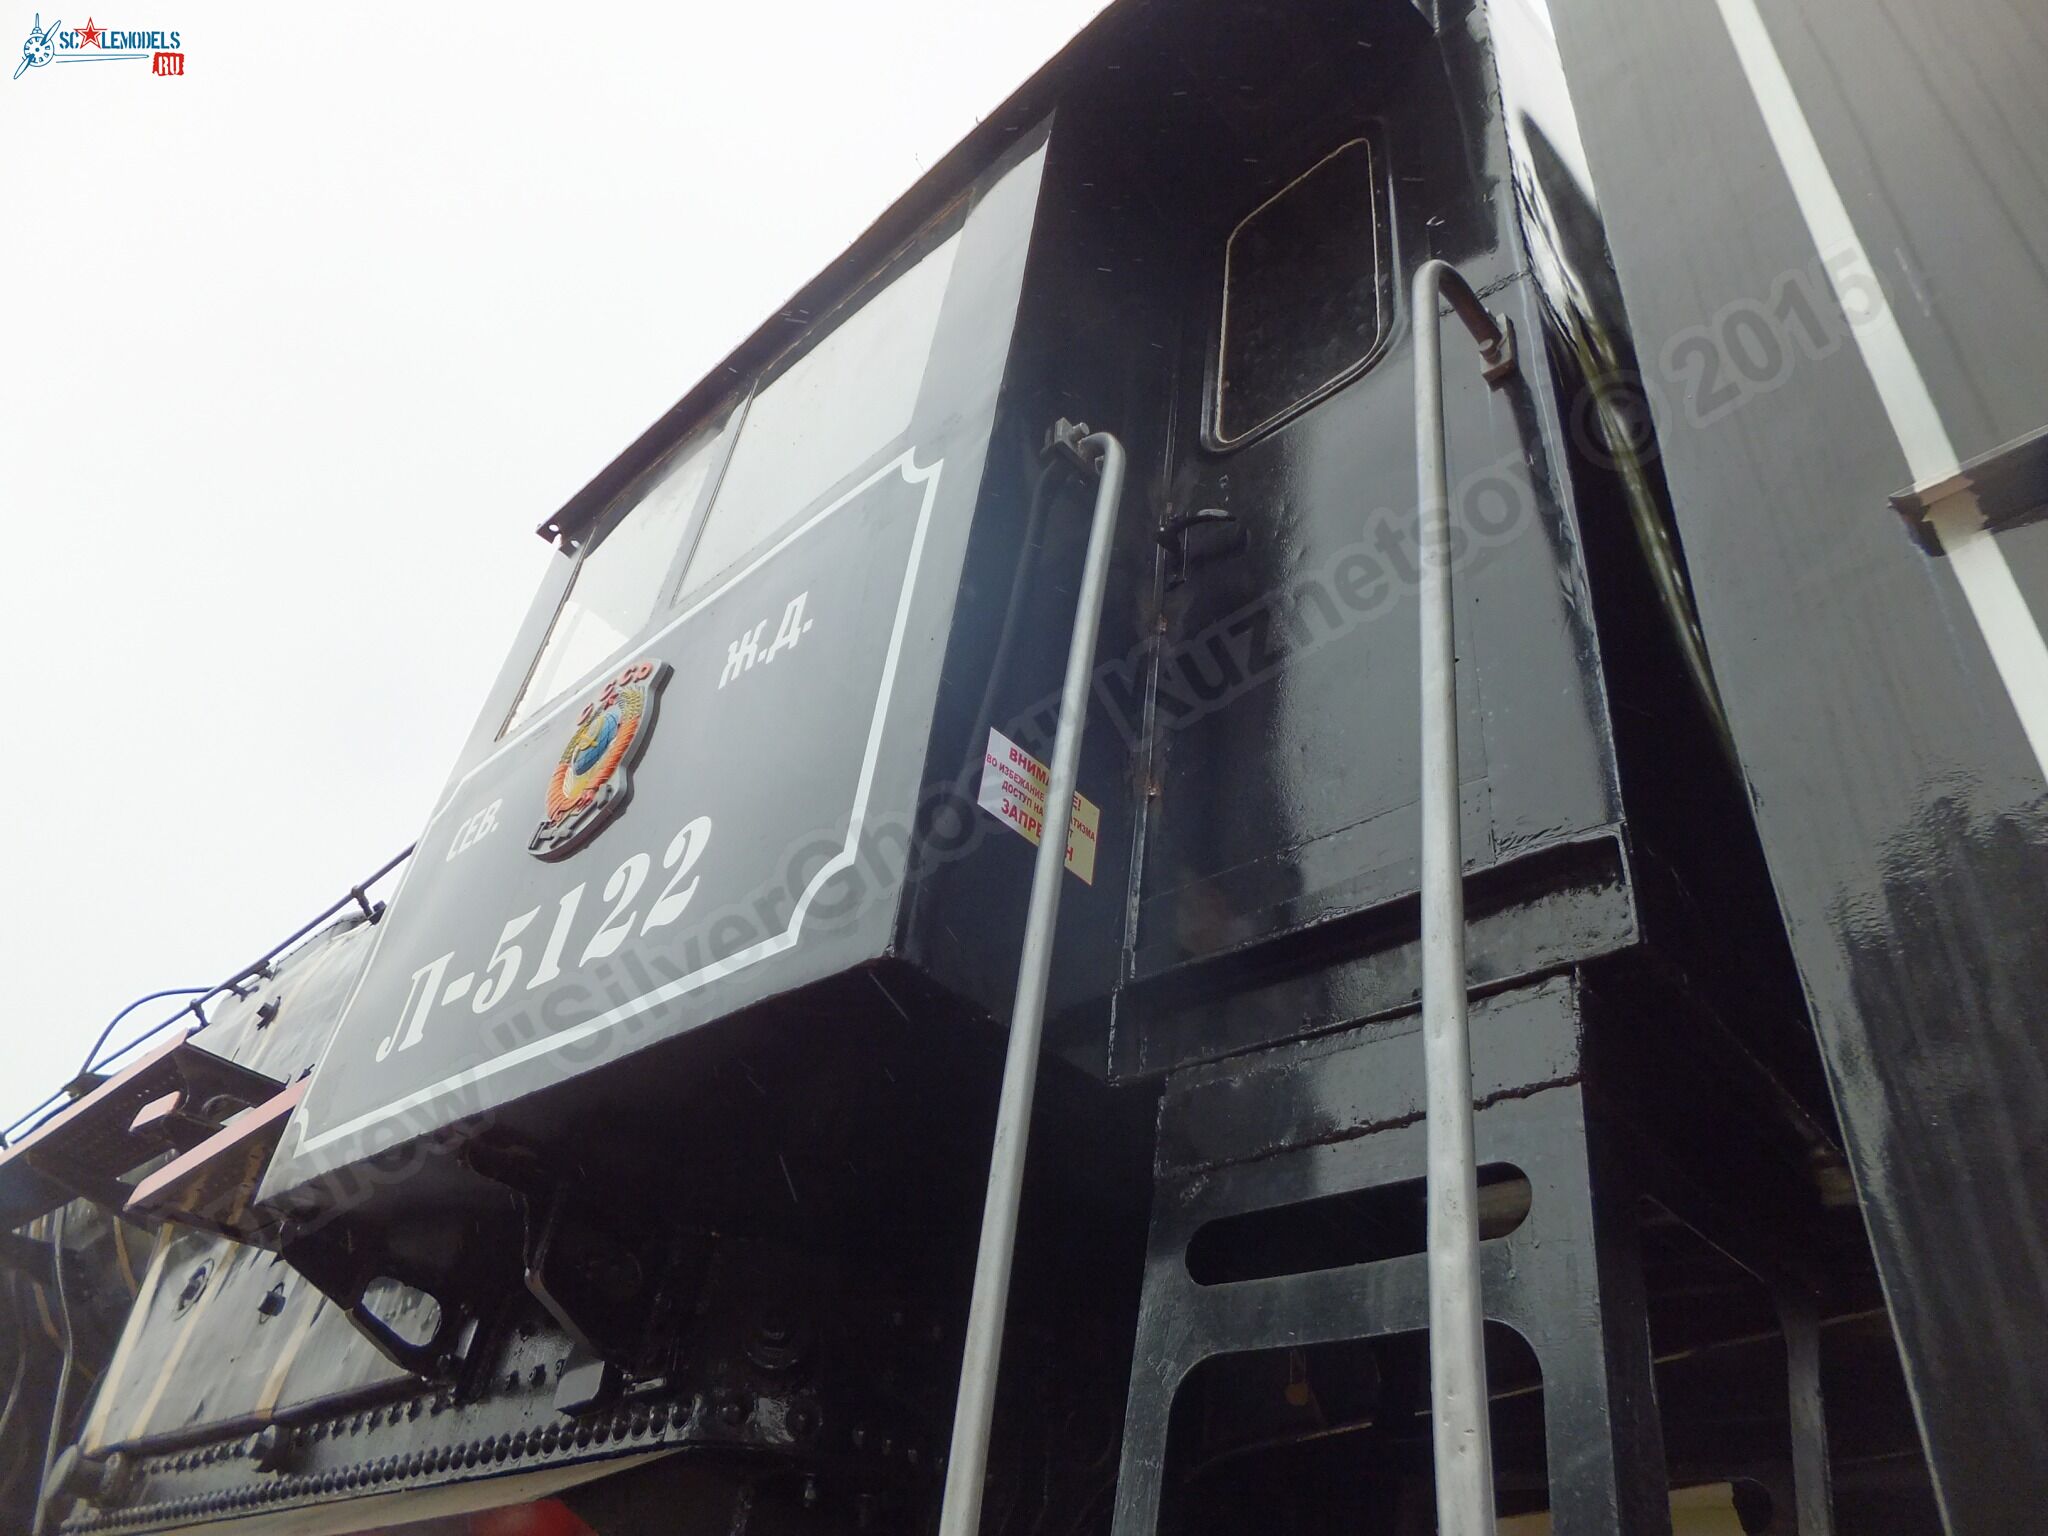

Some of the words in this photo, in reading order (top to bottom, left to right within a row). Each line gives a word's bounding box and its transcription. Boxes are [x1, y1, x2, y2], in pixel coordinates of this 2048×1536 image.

[986, 753, 998, 768] ВО
[1002, 780, 1032, 809] ДОСТУП
[1034, 802, 1044, 817] НА
[446, 798, 502, 862] СЕВ.
[376, 815, 712, 1063] Л-5122
